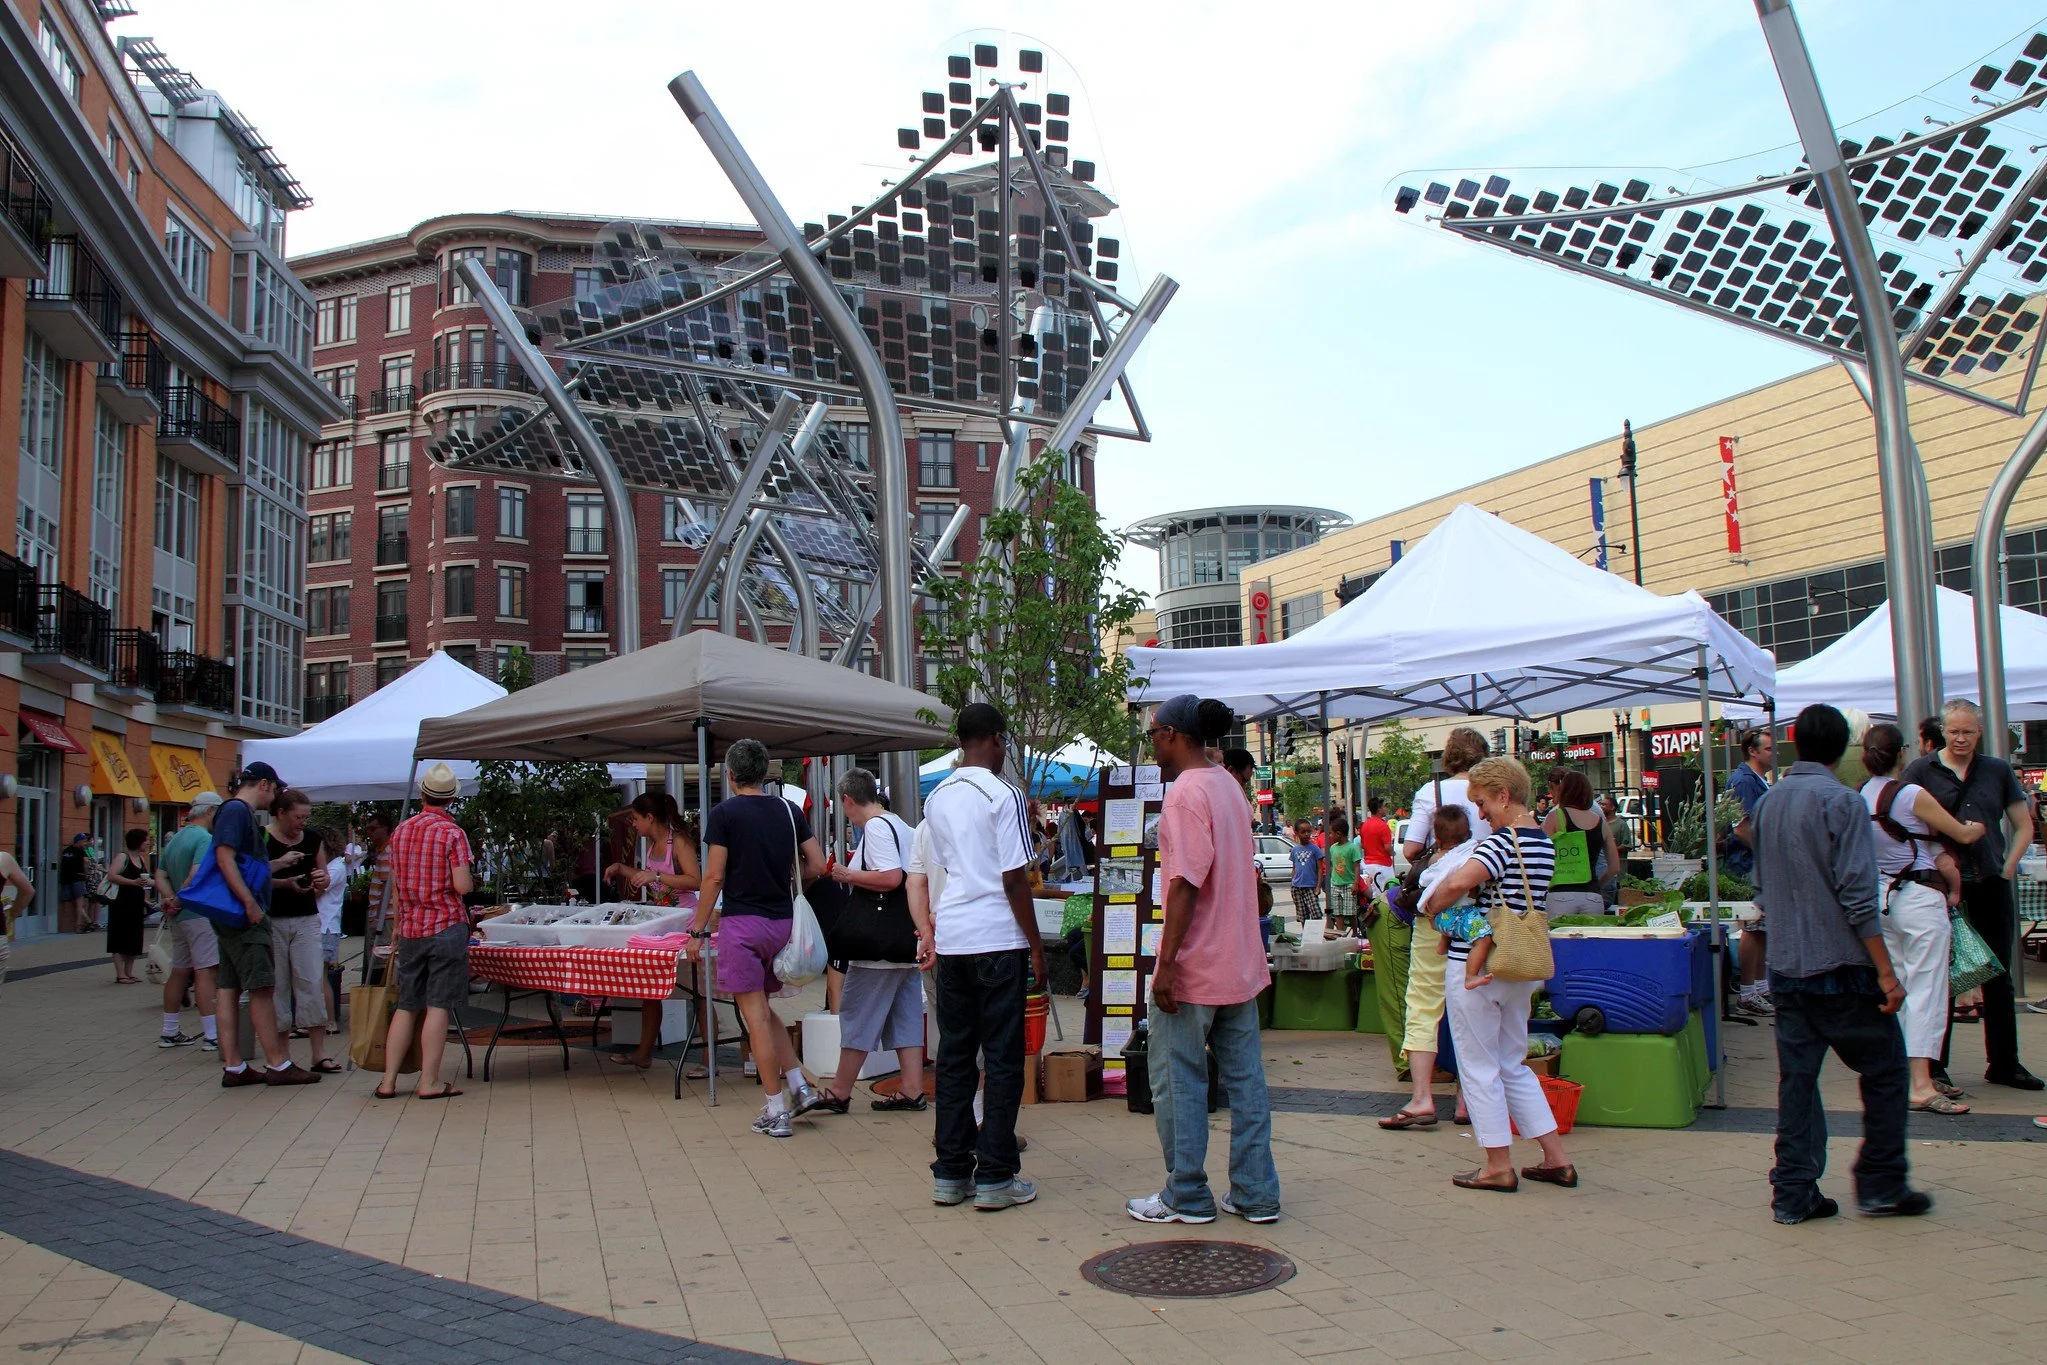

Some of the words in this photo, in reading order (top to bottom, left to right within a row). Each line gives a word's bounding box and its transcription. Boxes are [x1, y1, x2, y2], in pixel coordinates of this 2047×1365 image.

[1255, 613, 1268, 644] TA
[1651, 730, 1704, 755] STAPL
[1558, 846, 1580, 861] pa
